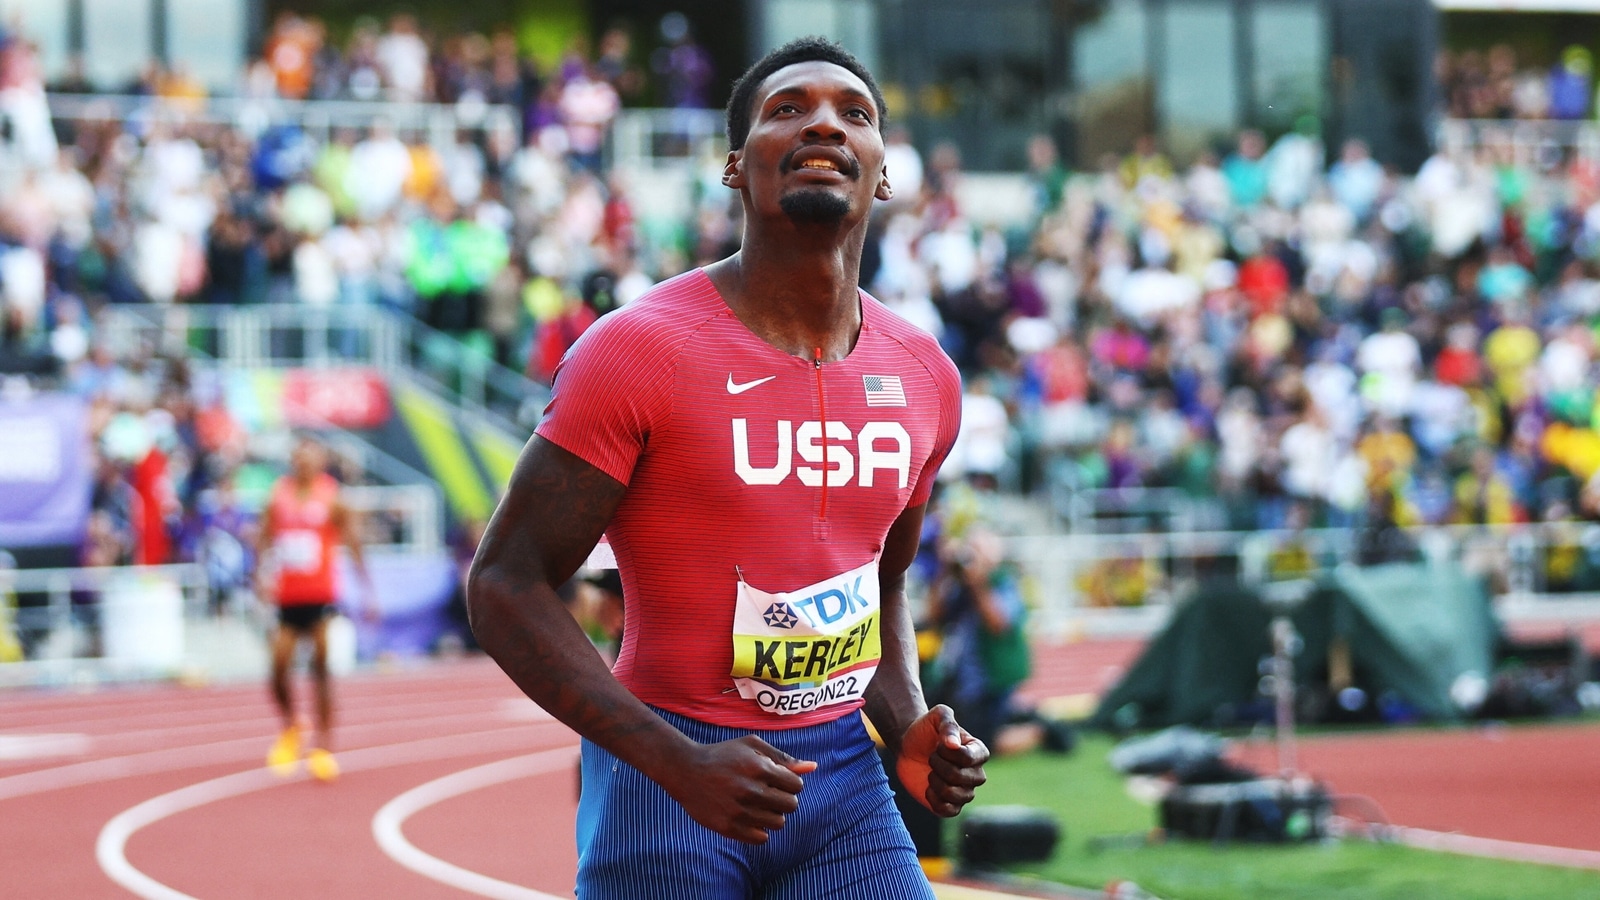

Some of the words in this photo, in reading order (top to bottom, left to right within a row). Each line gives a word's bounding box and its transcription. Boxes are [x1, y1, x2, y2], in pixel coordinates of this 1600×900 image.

[732, 418, 911, 488] USA
[793, 575, 868, 627] TDK
[753, 618, 873, 680] KERLEY
[757, 676, 859, 711] OREGON22
